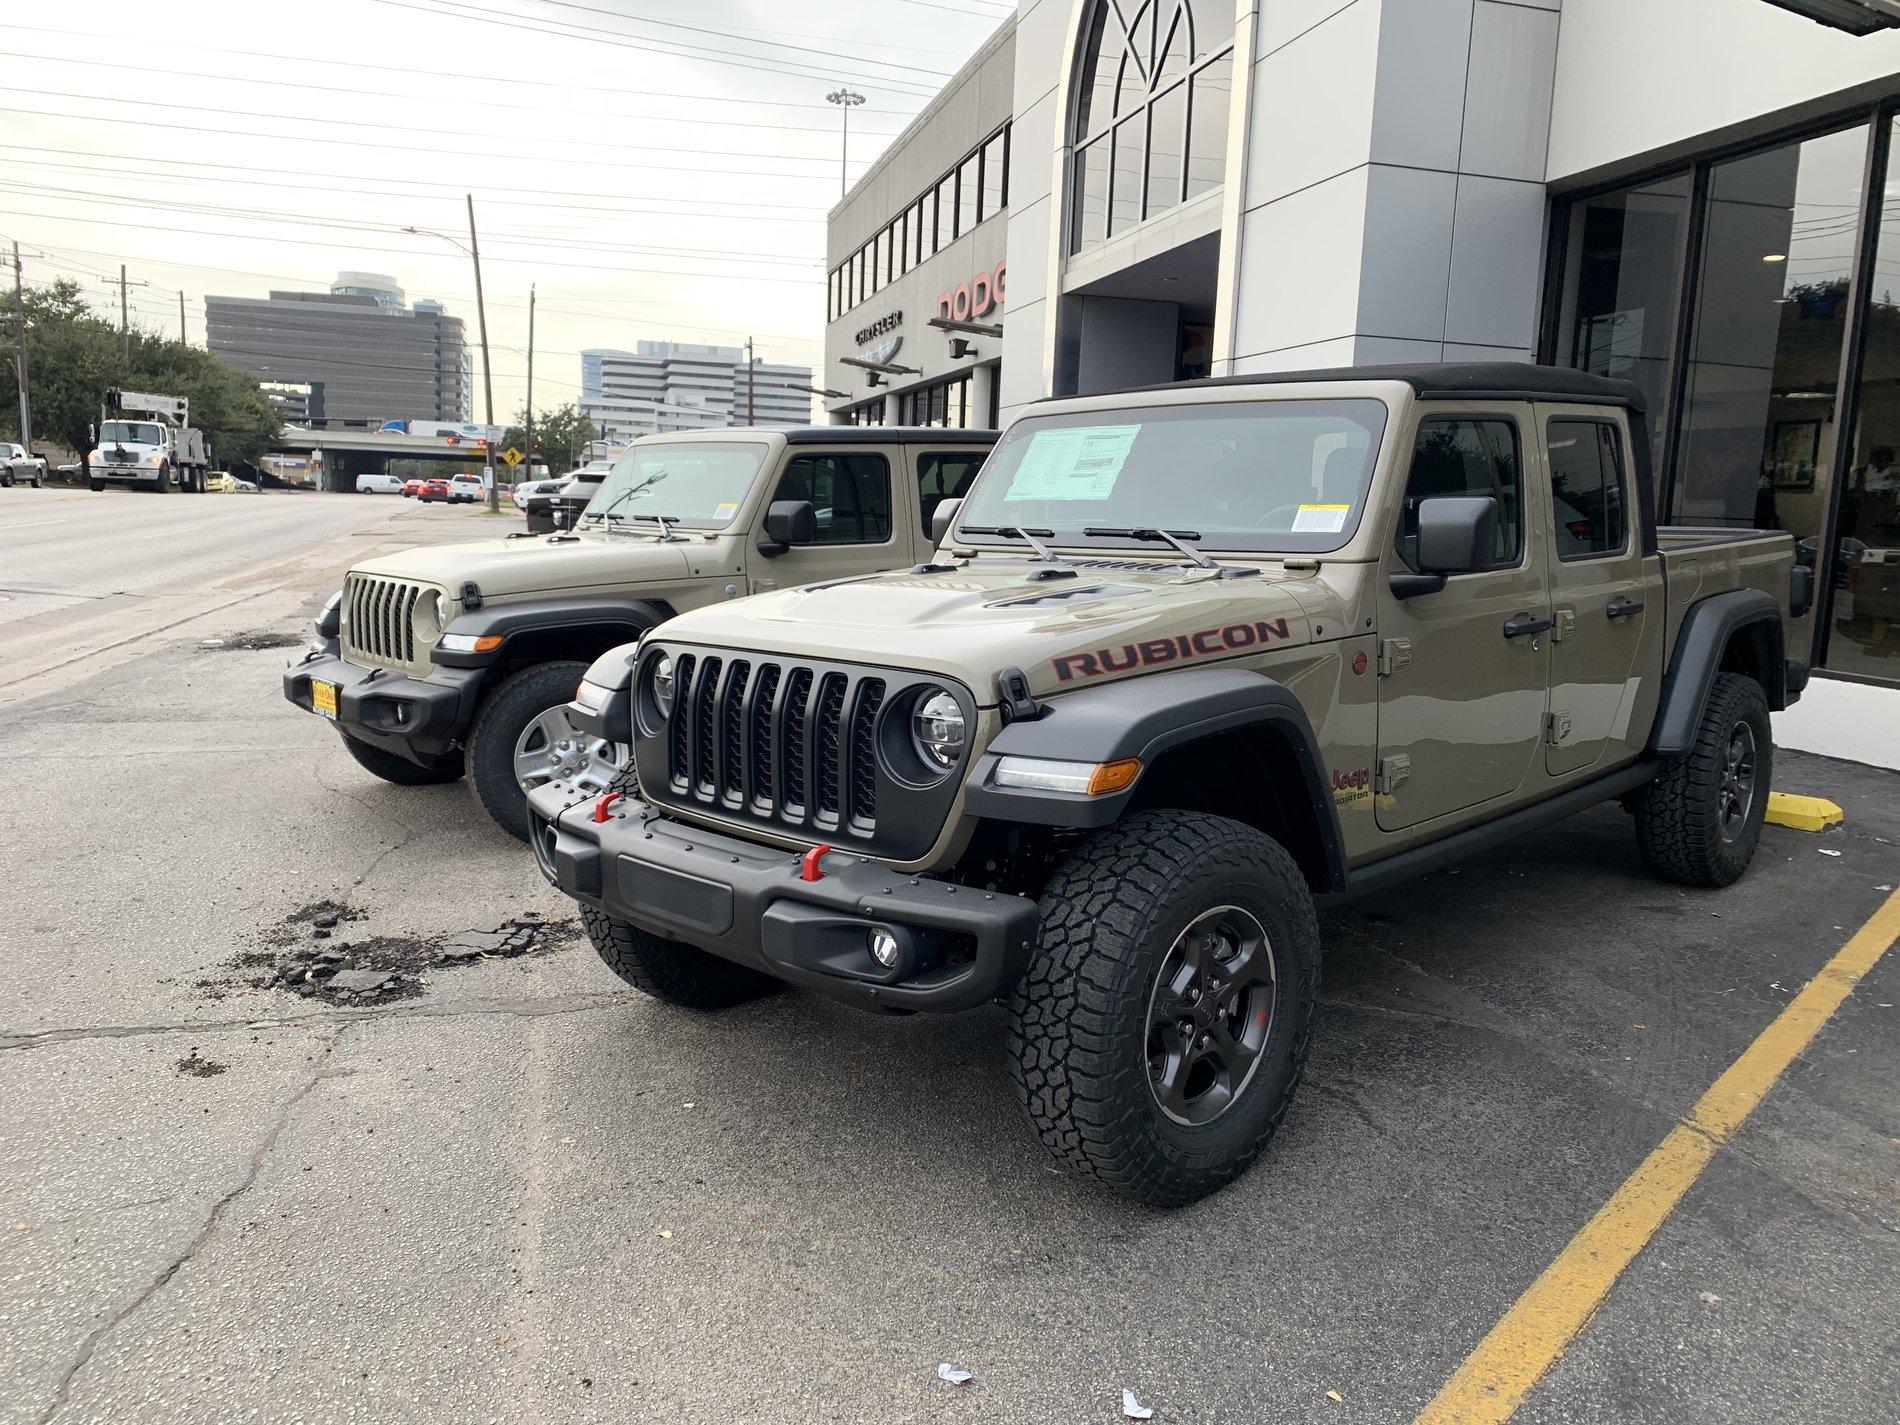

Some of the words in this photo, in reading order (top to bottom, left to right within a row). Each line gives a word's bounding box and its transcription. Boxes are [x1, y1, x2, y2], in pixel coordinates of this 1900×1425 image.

[854, 310, 902, 346] CHRYSLER
[1051, 617, 1290, 683] RUBICON
[1331, 768, 1369, 791] Jeep
